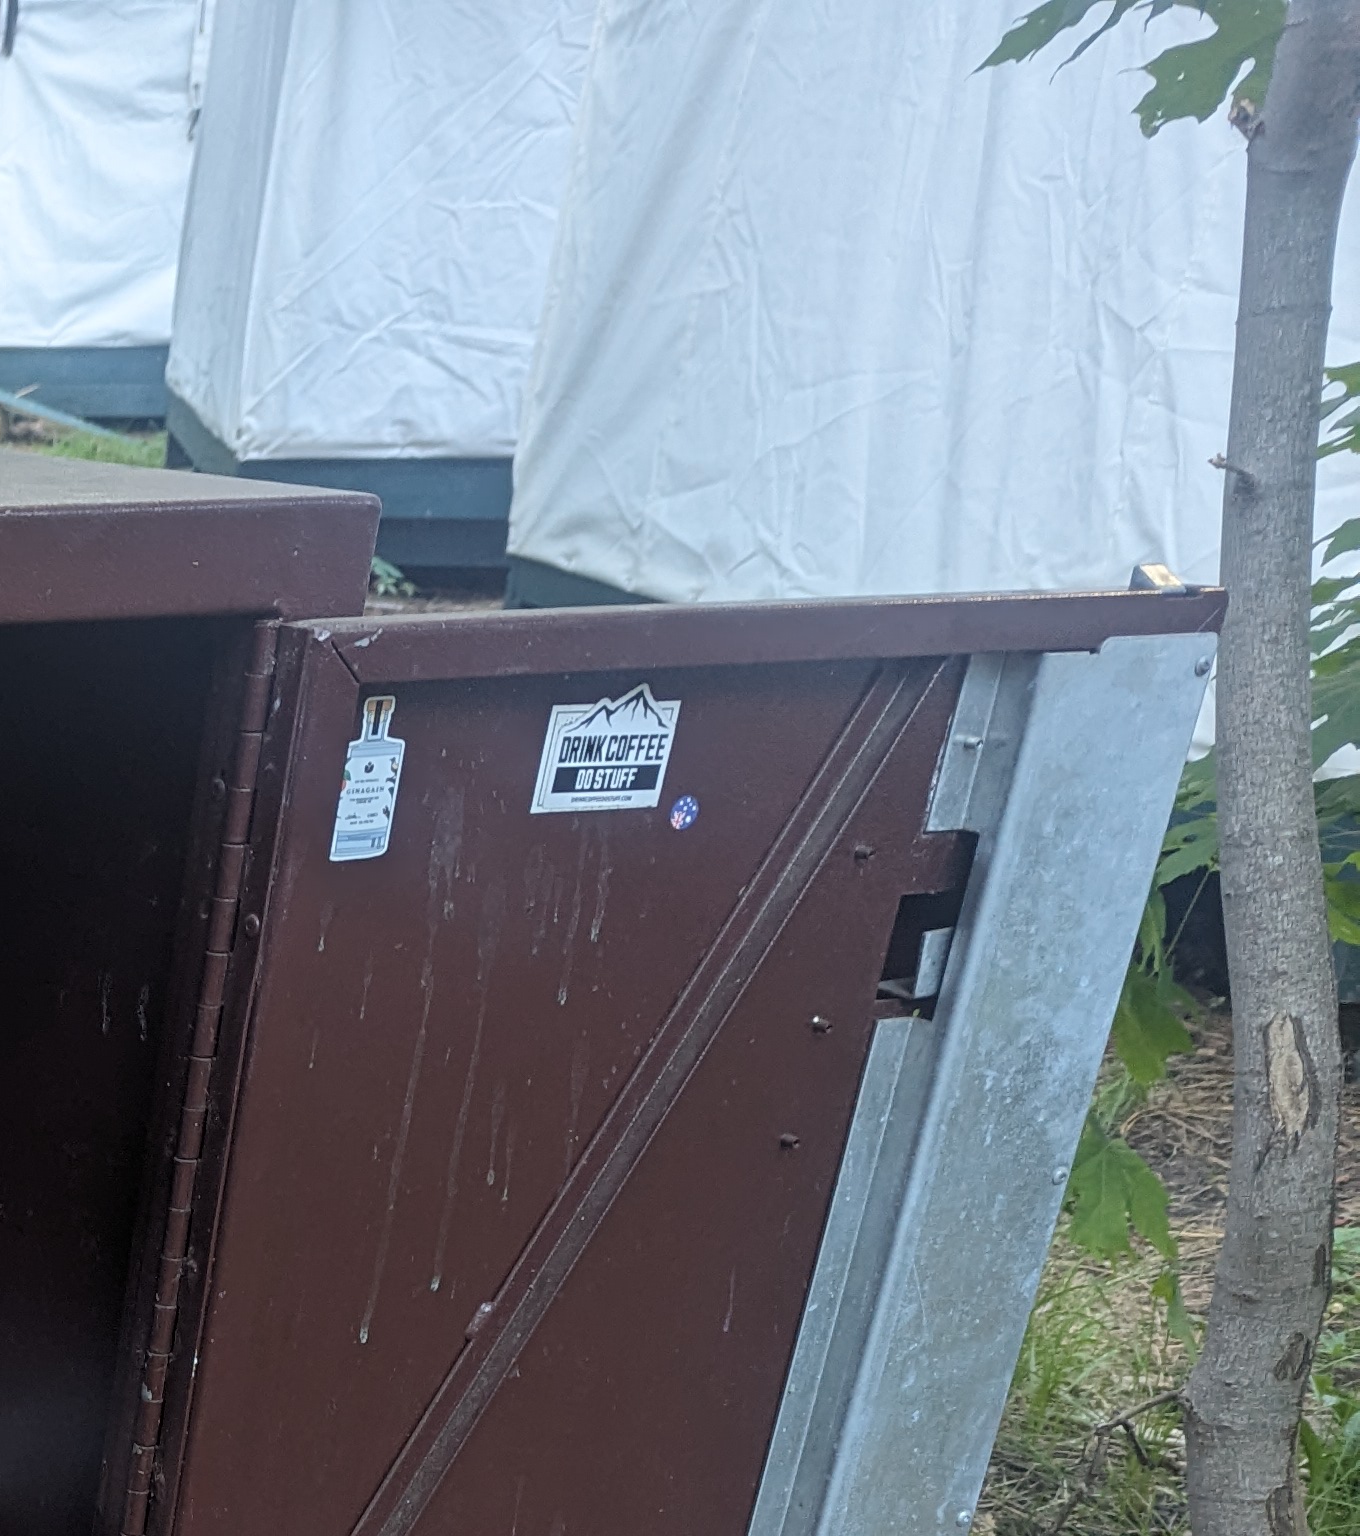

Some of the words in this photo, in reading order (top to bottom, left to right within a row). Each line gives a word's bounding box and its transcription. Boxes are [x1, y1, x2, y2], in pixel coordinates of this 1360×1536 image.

[558, 735, 607, 763] DRINK
[605, 734, 669, 762] COFFEE
[575, 769, 594, 790] DO
[593, 768, 638, 789] STUFF
